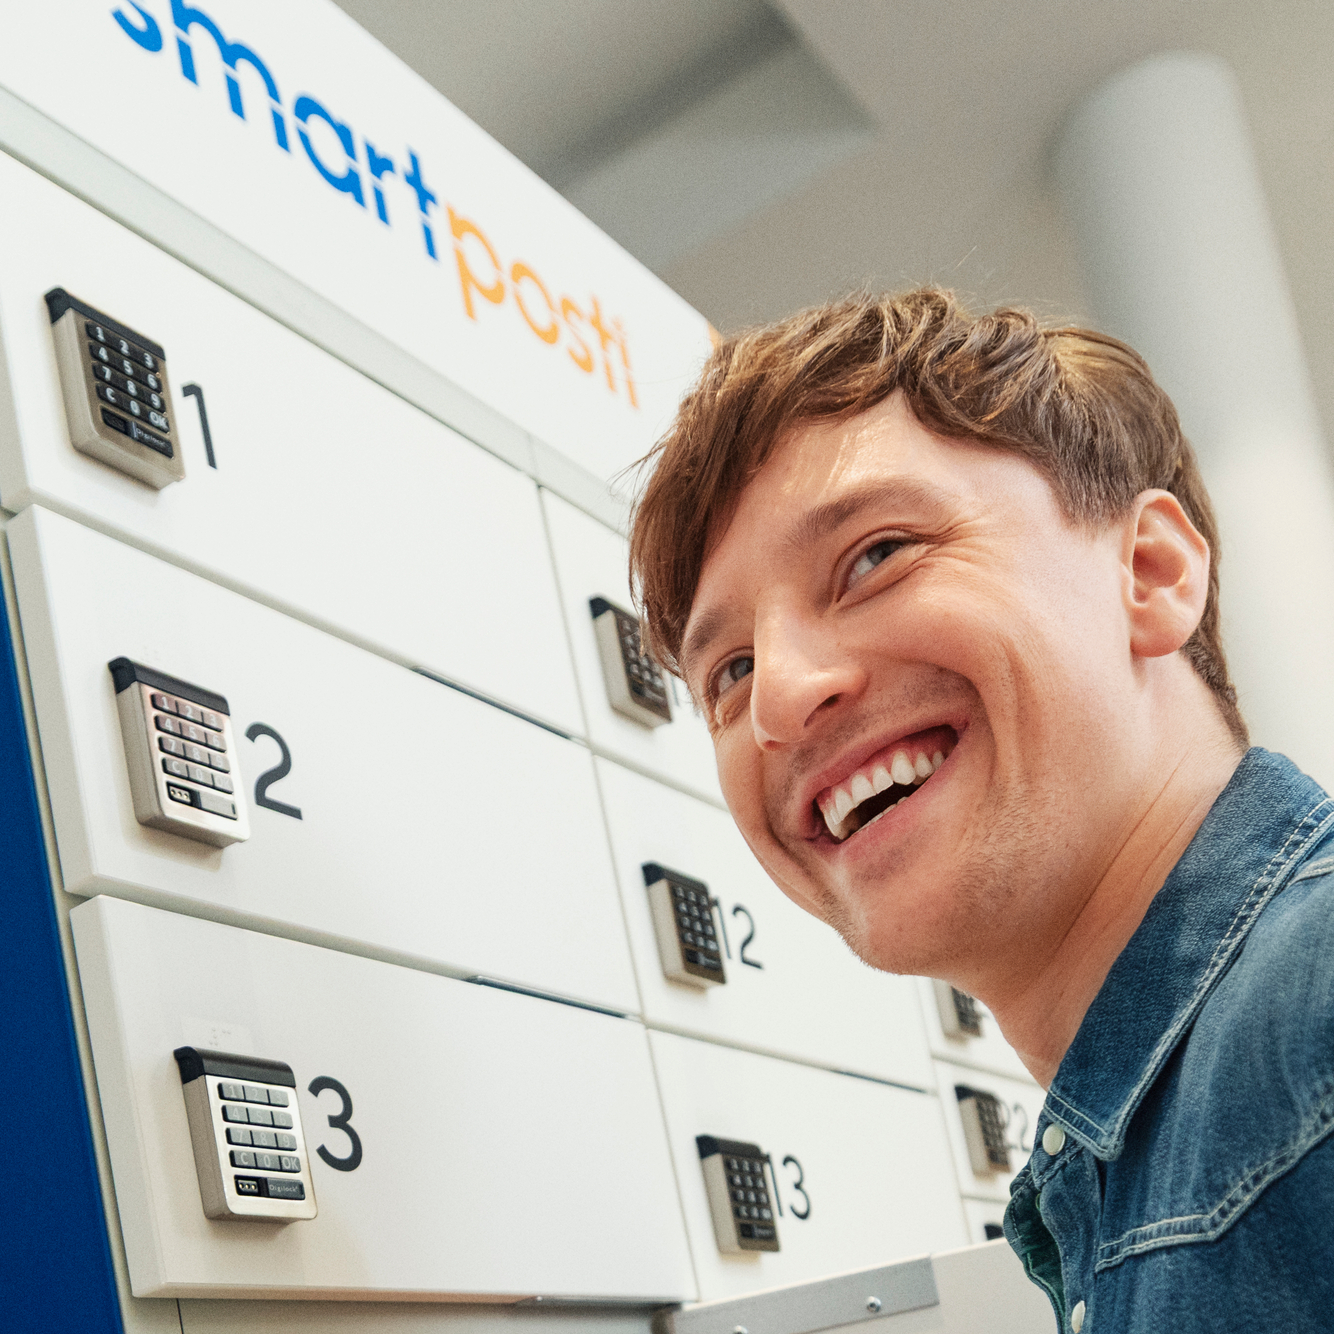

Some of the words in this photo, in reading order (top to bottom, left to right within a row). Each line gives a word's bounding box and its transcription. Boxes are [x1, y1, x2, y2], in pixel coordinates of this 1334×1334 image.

[96, 327, 106, 342] 1
[120, 340, 130, 356] 2
[144, 352, 154, 369] 3
[99, 347, 108, 362] 4
[123, 359, 133, 375] 5
[147, 373, 158, 389] 6
[102, 366, 111, 381] 7
[127, 380, 137, 396] 8
[151, 394, 161, 409] 9
[106, 388, 116, 402] C
[130, 401, 140, 416] 0
[149, 411, 168, 430] OK
[182, 383, 217, 469] 1
[162, 697, 169, 709] 1
[185, 705, 193, 718] 2
[211, 714, 217, 726] 3
[165, 718, 172, 731] 4
[189, 726, 197, 739] 5
[213, 735, 220, 747] 6
[169, 739, 176, 751] 7
[193, 748, 200, 760] 8
[172, 761, 180, 773] C
[245, 721, 303, 821] 2
[709, 898, 763, 969] 12
[229, 1086, 237, 1098] 1
[233, 1108, 240, 1119] 4
[256, 1111, 263, 1122] 5
[307, 1075, 363, 1172] 3
[236, 1130, 243, 1142] 7
[260, 1133, 267, 1145] 8
[283, 1135, 290, 1147] 9
[240, 1153, 247, 1164] C
[282, 1157, 298, 1169] OK
[762, 1153, 811, 1220] 13
